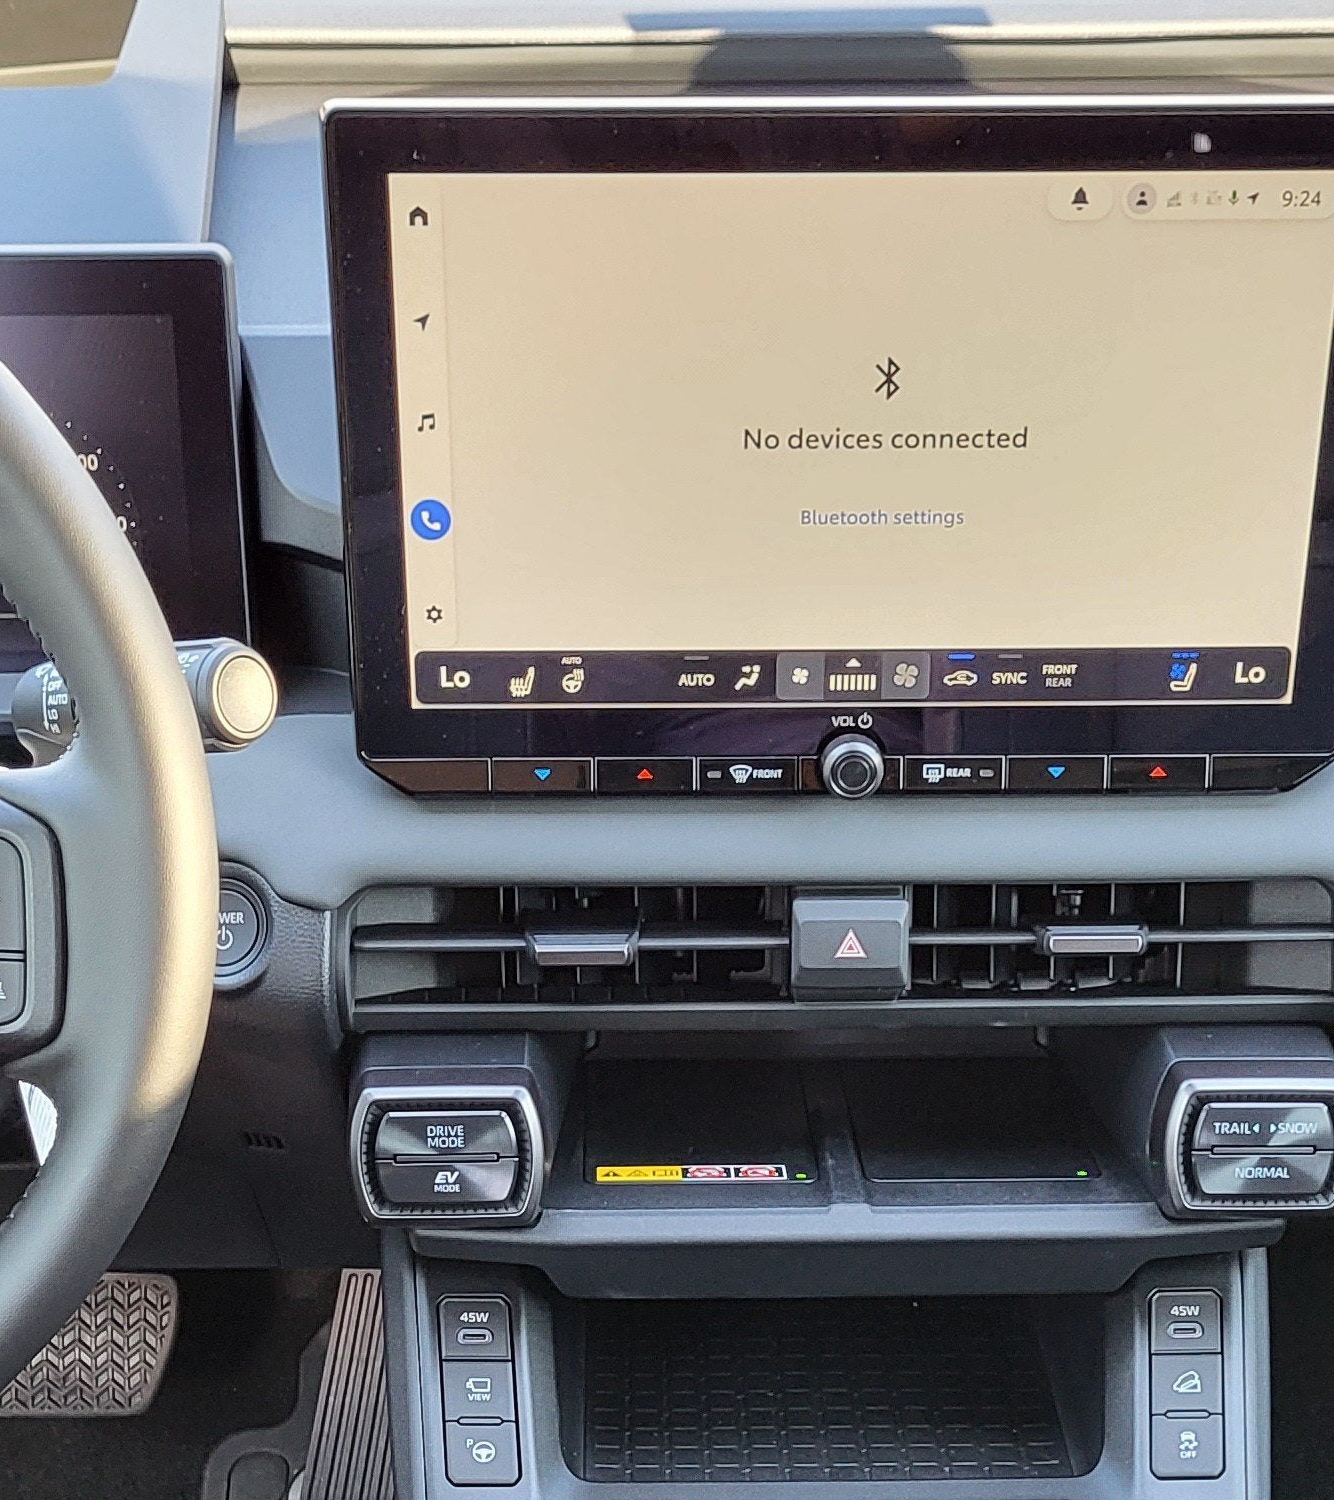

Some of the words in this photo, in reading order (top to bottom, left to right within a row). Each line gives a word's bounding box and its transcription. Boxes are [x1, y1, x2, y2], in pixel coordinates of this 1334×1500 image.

[1281, 190, 1321, 207] 9:24
[743, 427, 780, 450] No
[787, 427, 883, 450] devices
[890, 426, 1029, 449] connected
[800, 510, 887, 525] Bluetooth
[893, 510, 964, 528] settings
[1042, 663, 1078, 676] FRONT
[1234, 662, 1267, 684] Lo
[440, 666, 471, 688] Lo
[678, 673, 716, 687] AUTO
[991, 671, 1028, 686] SYNC
[1045, 676, 1072, 688] REAR
[831, 715, 855, 727] VOL
[753, 769, 783, 780] FRONT
[946, 768, 971, 778] REAR
[218, 911, 244, 924] WER
[426, 1125, 465, 1137] DRIVE
[1213, 1122, 1252, 1135] TRAIL
[1277, 1122, 1318, 1135] SNOW
[427, 1137, 465, 1148] MODE
[434, 1171, 460, 1184] EV
[1234, 1166, 1290, 1179] NORMAL
[434, 1184, 461, 1193] MODE
[1170, 1305, 1200, 1316] 45W
[460, 1312, 489, 1323] 45W
[467, 1393, 491, 1402] VIEW
[466, 1439, 474, 1448] P
[1180, 1451, 1197, 1459] OFF
